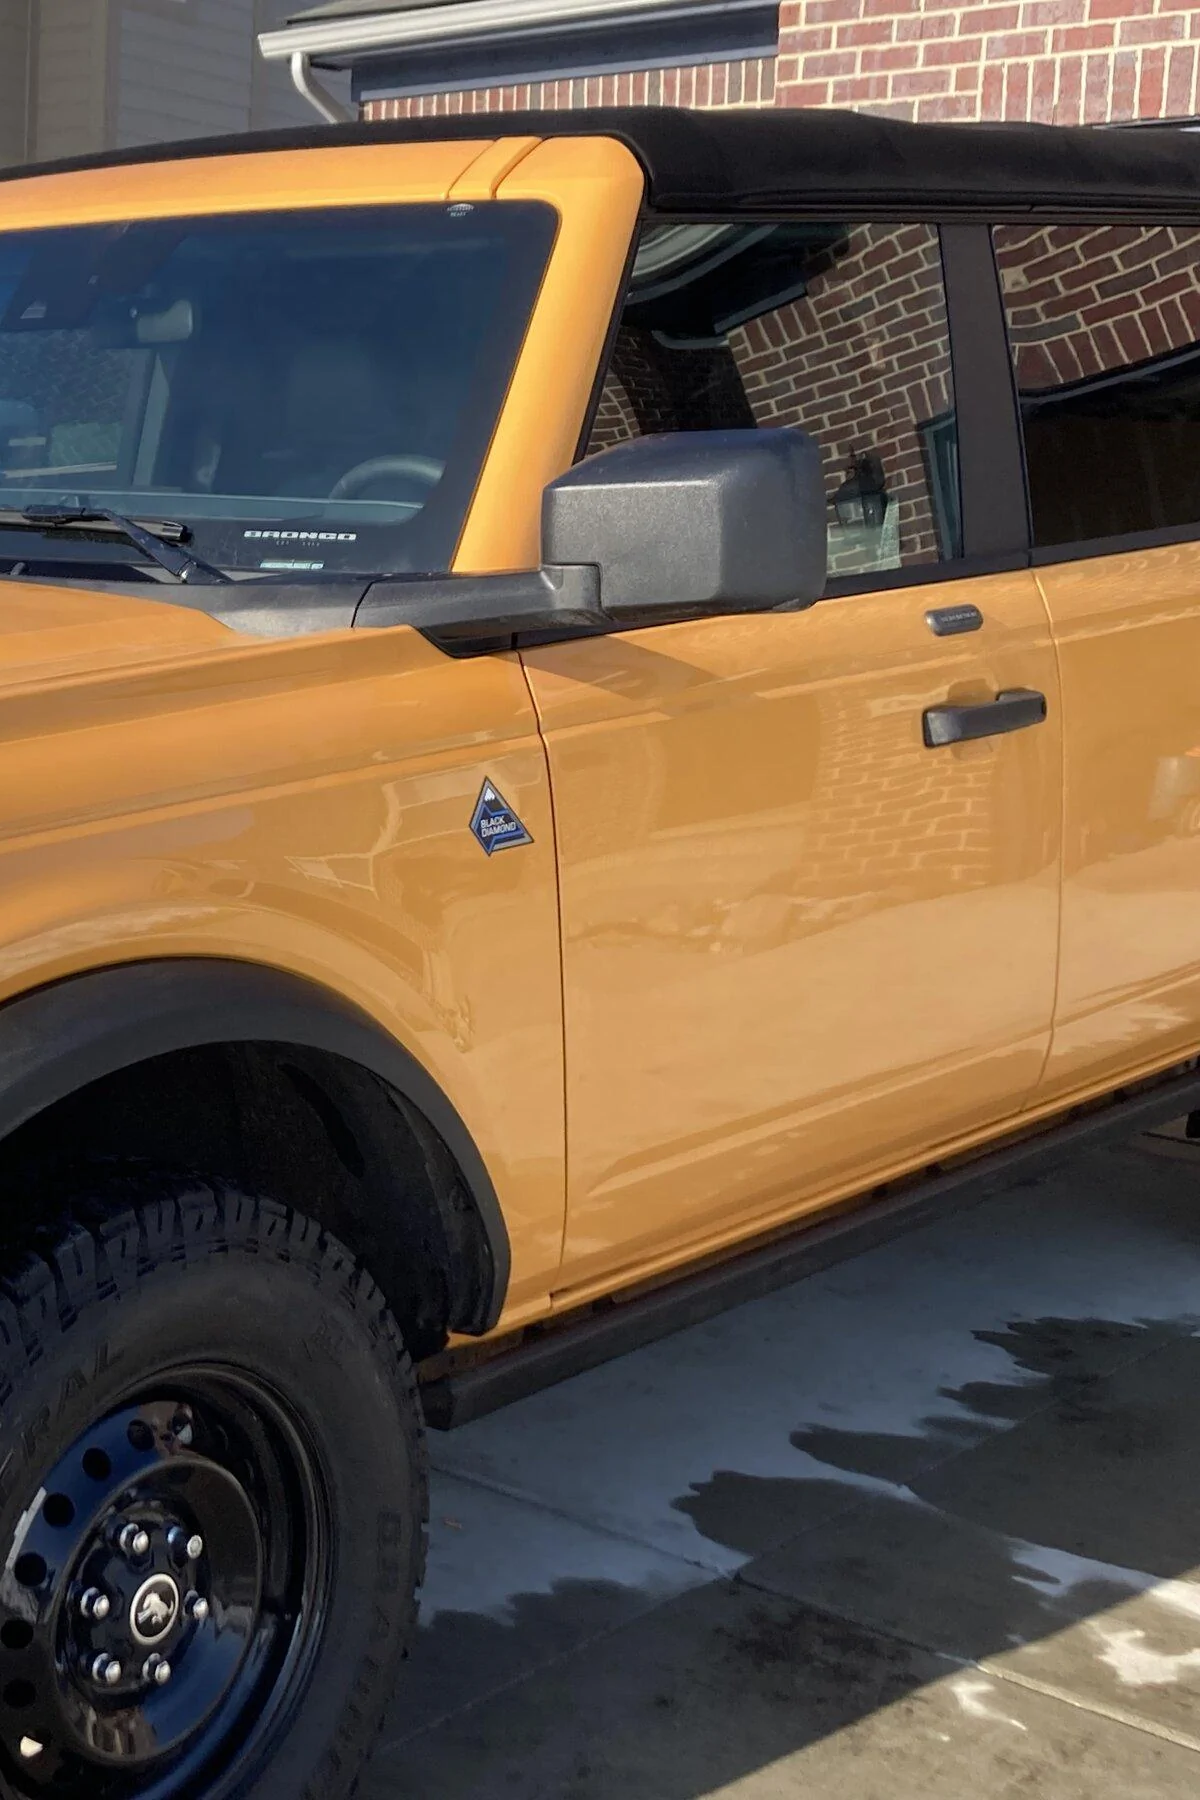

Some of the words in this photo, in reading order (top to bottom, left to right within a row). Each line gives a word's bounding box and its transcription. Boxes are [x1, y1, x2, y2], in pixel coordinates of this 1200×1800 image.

[243, 530, 357, 541] BRONCO
[480, 815, 505, 828] BLACK
[481, 822, 517, 838] DIAMOND
